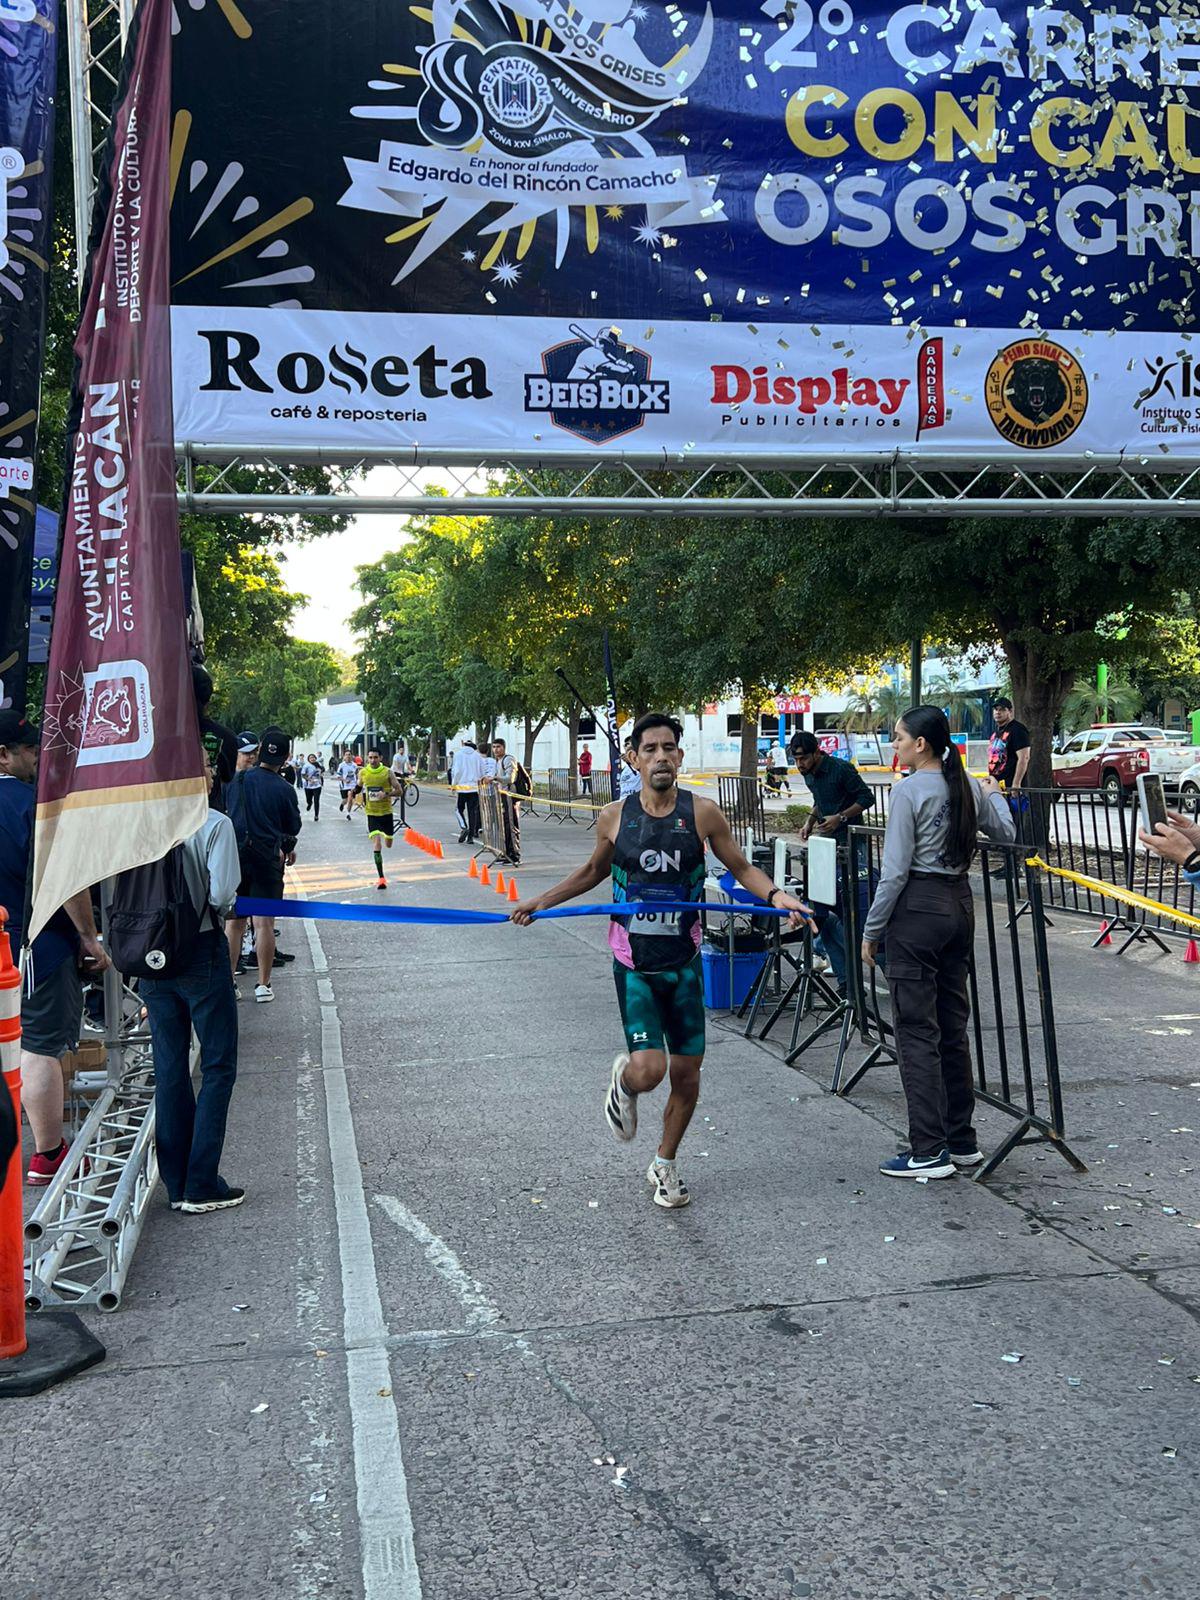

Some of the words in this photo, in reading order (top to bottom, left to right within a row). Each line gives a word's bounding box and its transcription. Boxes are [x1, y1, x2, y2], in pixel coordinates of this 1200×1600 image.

[553, 13, 599, 58] OSOS
[600, 54, 667, 87] GRISES
[482, 60, 548, 96] PENTATHLON
[489, 127, 512, 147] ZONA
[514, 140, 531, 148] XXV
[533, 131, 572, 145] SINALOA
[785, 85, 998, 163] CON
[388, 156, 473, 185] Edgardo
[477, 171, 507, 189] del
[513, 174, 580, 192] Rincón
[586, 170, 678, 192] Camacho
[470, 157, 486, 169] En
[488, 158, 527, 171] honor
[528, 161, 540, 172] al
[542, 161, 599, 173] fundador
[129, 196, 142, 219] LA
[754, 172, 1026, 252] OSOS
[130, 225, 141, 236] Y
[113, 213, 128, 307] INSTITUTO
[129, 239, 142, 322] DEPORTE
[198, 330, 493, 399] Roseta
[1033, 343, 1073, 371] SINALA
[710, 365, 911, 414] Display
[926, 346, 938, 425] BANDERAS
[271, 405, 312, 418] café
[317, 405, 329, 418] &
[334, 408, 427, 422] reposteria
[722, 415, 901, 427] Publicitarios
[998, 412, 1075, 446] TAEKWONDO
[1141, 422, 1178, 433] Cultura
[1142, 407, 1192, 419] Instituto
[73, 432, 105, 641] AYUNTAMIENTO
[120, 541, 134, 632] CAPITAL
[640, 849, 680, 872] ON
